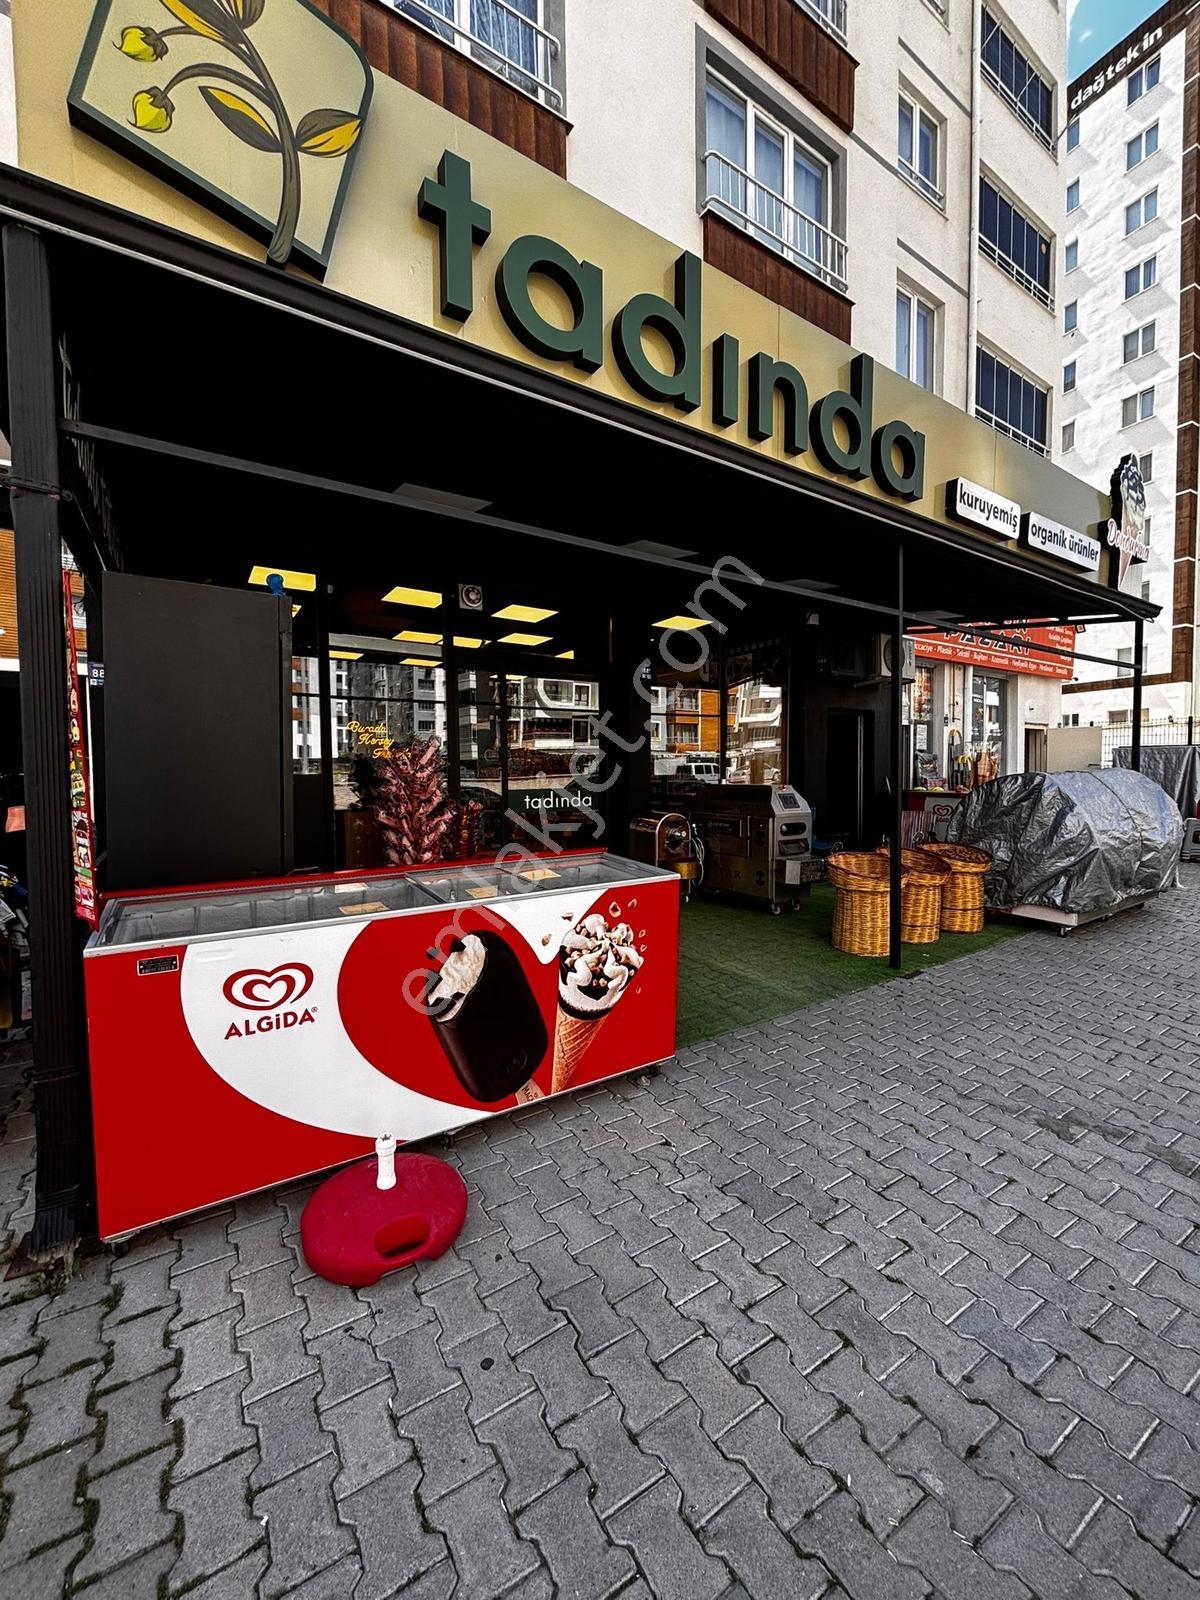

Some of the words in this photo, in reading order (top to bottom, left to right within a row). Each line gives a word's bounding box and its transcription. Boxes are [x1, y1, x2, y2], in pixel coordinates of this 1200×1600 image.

[1071, 27, 1162, 109] dağtekin
[417, 149, 926, 501] tadında
[959, 483, 1018, 532] kuruyemiş
[1031, 522, 1067, 548] organik
[1069, 534, 1099, 562] ürünler
[346, 720, 388, 732] Burada
[524, 790, 592, 809] tadında
